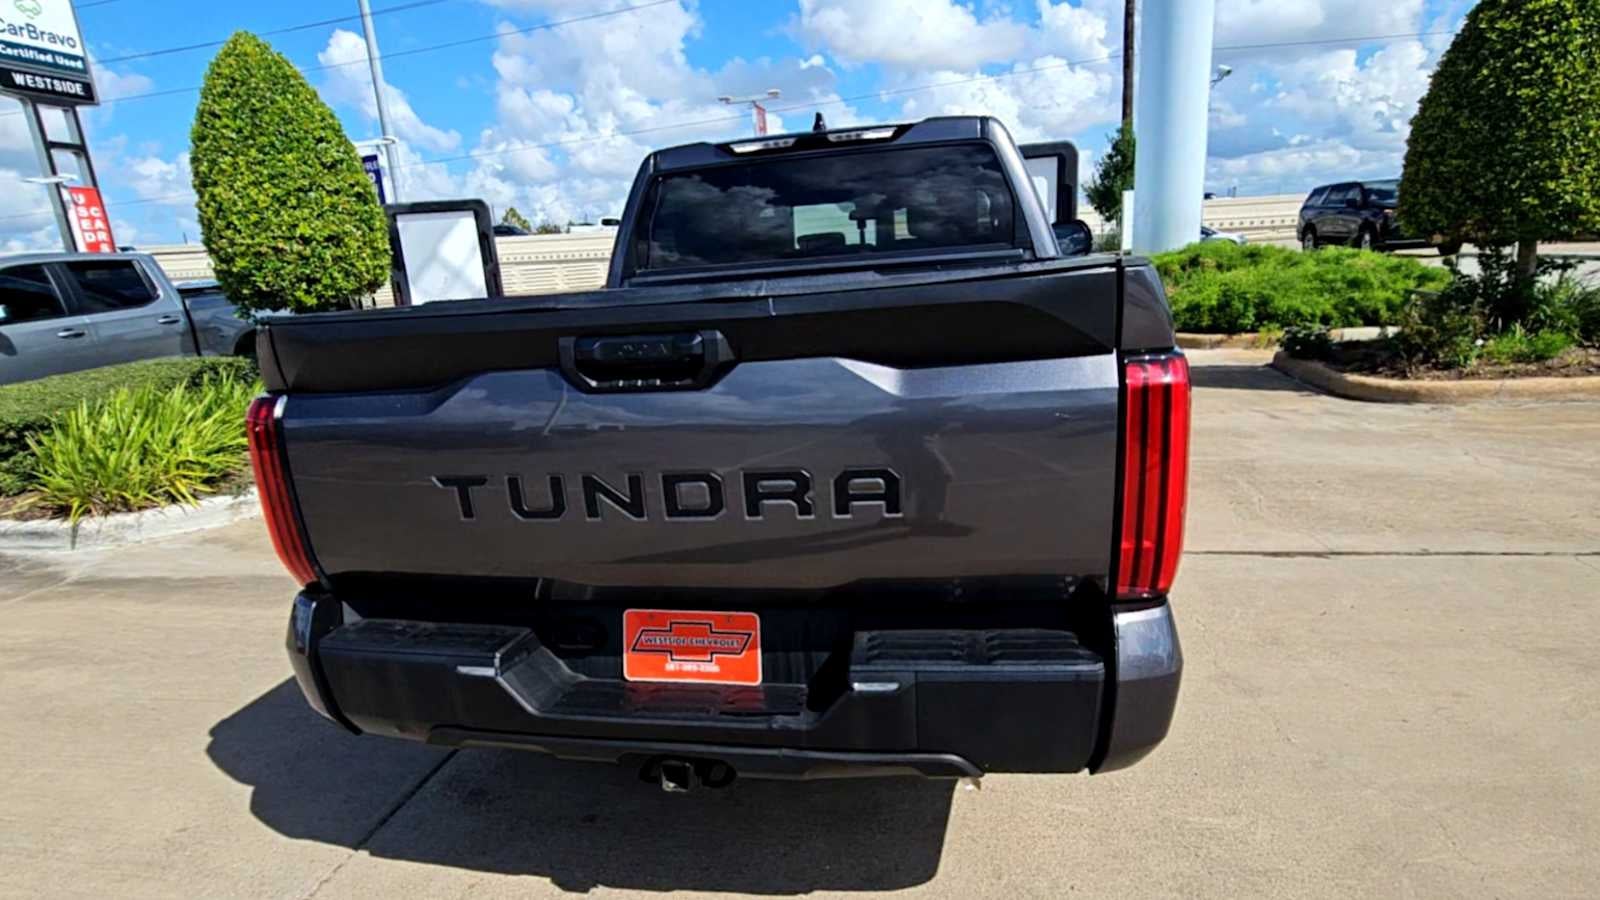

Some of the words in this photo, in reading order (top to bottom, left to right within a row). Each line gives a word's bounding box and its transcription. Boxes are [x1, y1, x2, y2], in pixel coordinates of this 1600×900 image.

[0, 44, 54, 62] Certified
[55, 55, 84, 69] Used
[11, 71, 84, 95] WESTSIDE
[71, 193, 96, 243] USED
[432, 468, 904, 521] TUNDRA
[643, 636, 686, 646] WESTSIDE
[688, 637, 740, 648] CHEVROLET
